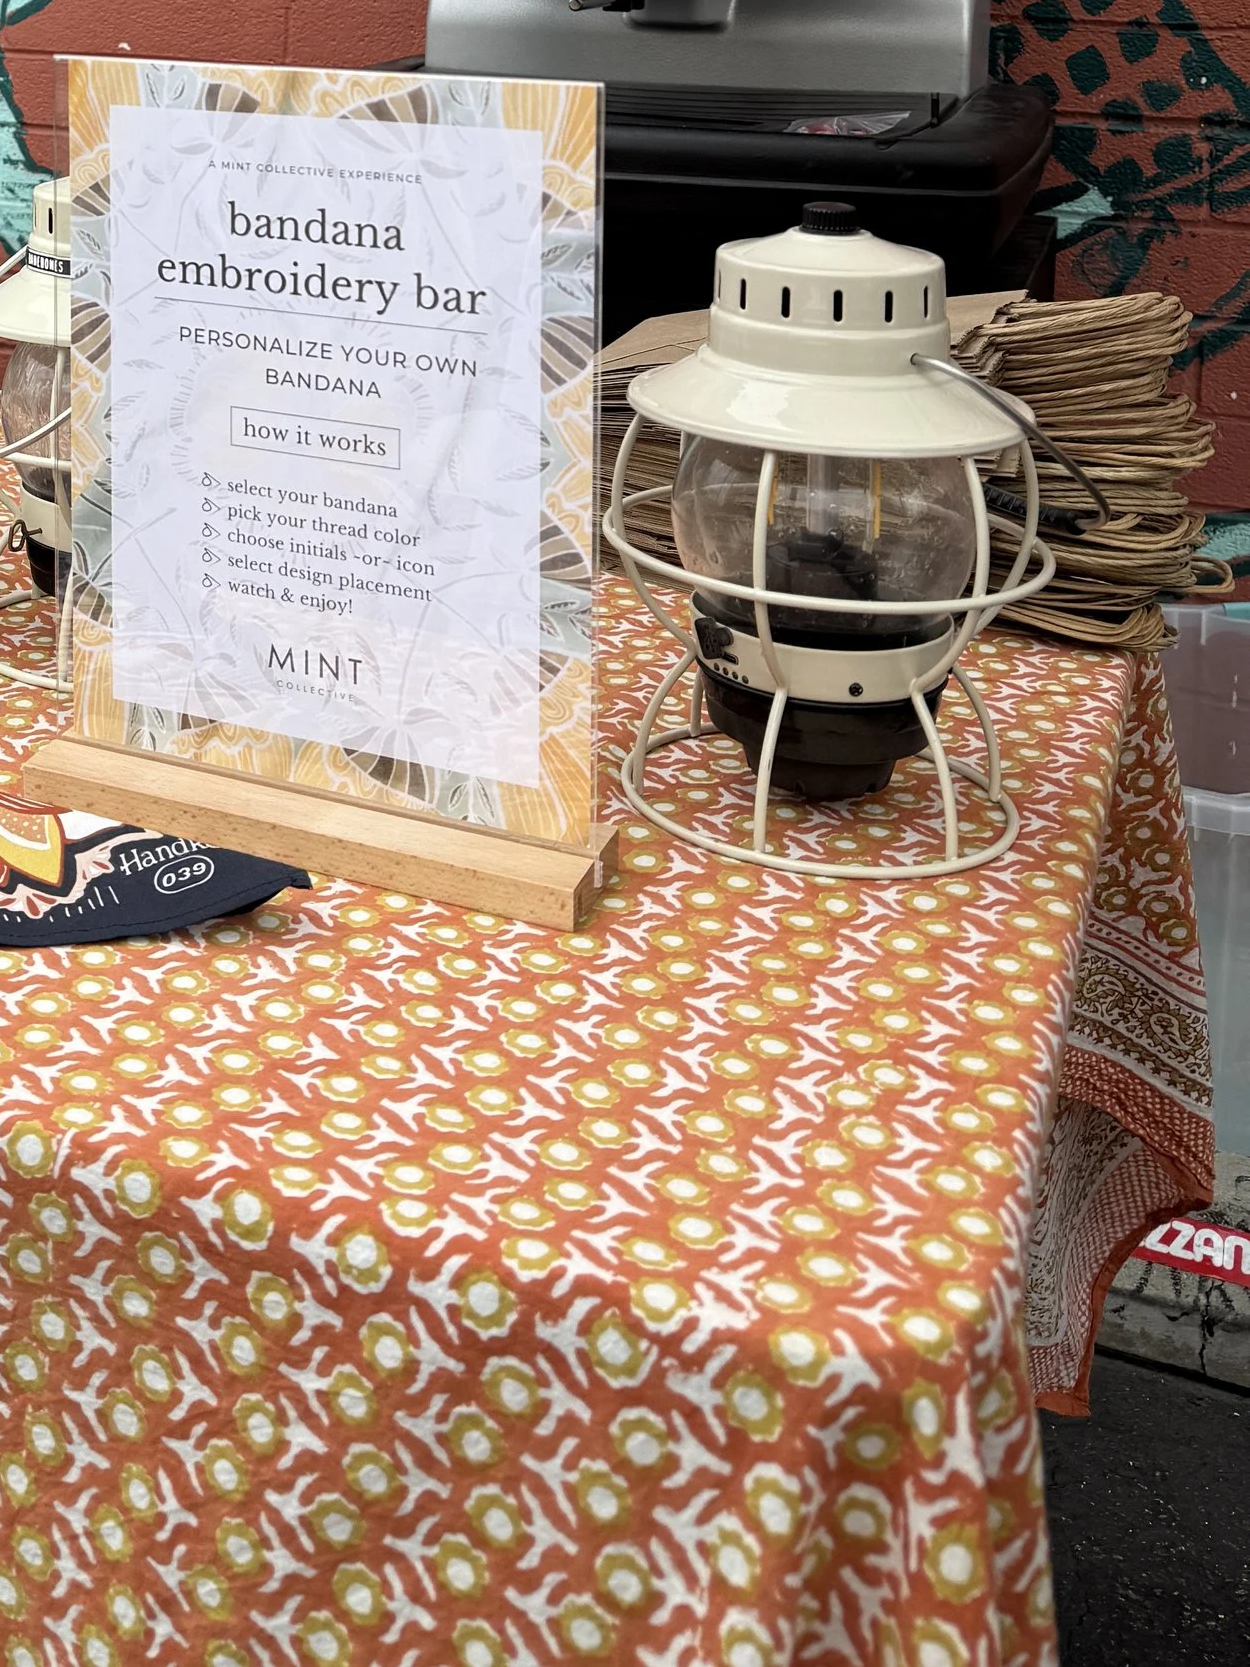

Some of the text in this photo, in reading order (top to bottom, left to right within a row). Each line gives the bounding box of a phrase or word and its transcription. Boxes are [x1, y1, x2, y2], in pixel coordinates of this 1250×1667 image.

[208, 160, 422, 184] A MINT COLLECTIVE EXPERIENCE
[228, 200, 405, 251] bandana
[157, 253, 487, 316] embroidery bar
[179, 325, 477, 377] PERSONALIZE YOUR OWN
[265, 368, 382, 398] BANDANA
[243, 417, 387, 456] how it works
[227, 479, 398, 518] select your bandana
[227, 503, 421, 547] pick your thread color
[227, 528, 285, 551] choose
[290, 538, 347, 562] initials
[396, 555, 435, 576] icon
[227, 554, 433, 602] select design placement
[227, 580, 353, 616] watch & enjoy!
[268, 643, 362, 685] MINT
[276, 679, 354, 702] COLLECTIVE
[119, 837, 220, 876] Handk
[162, 862, 206, 887] 039
